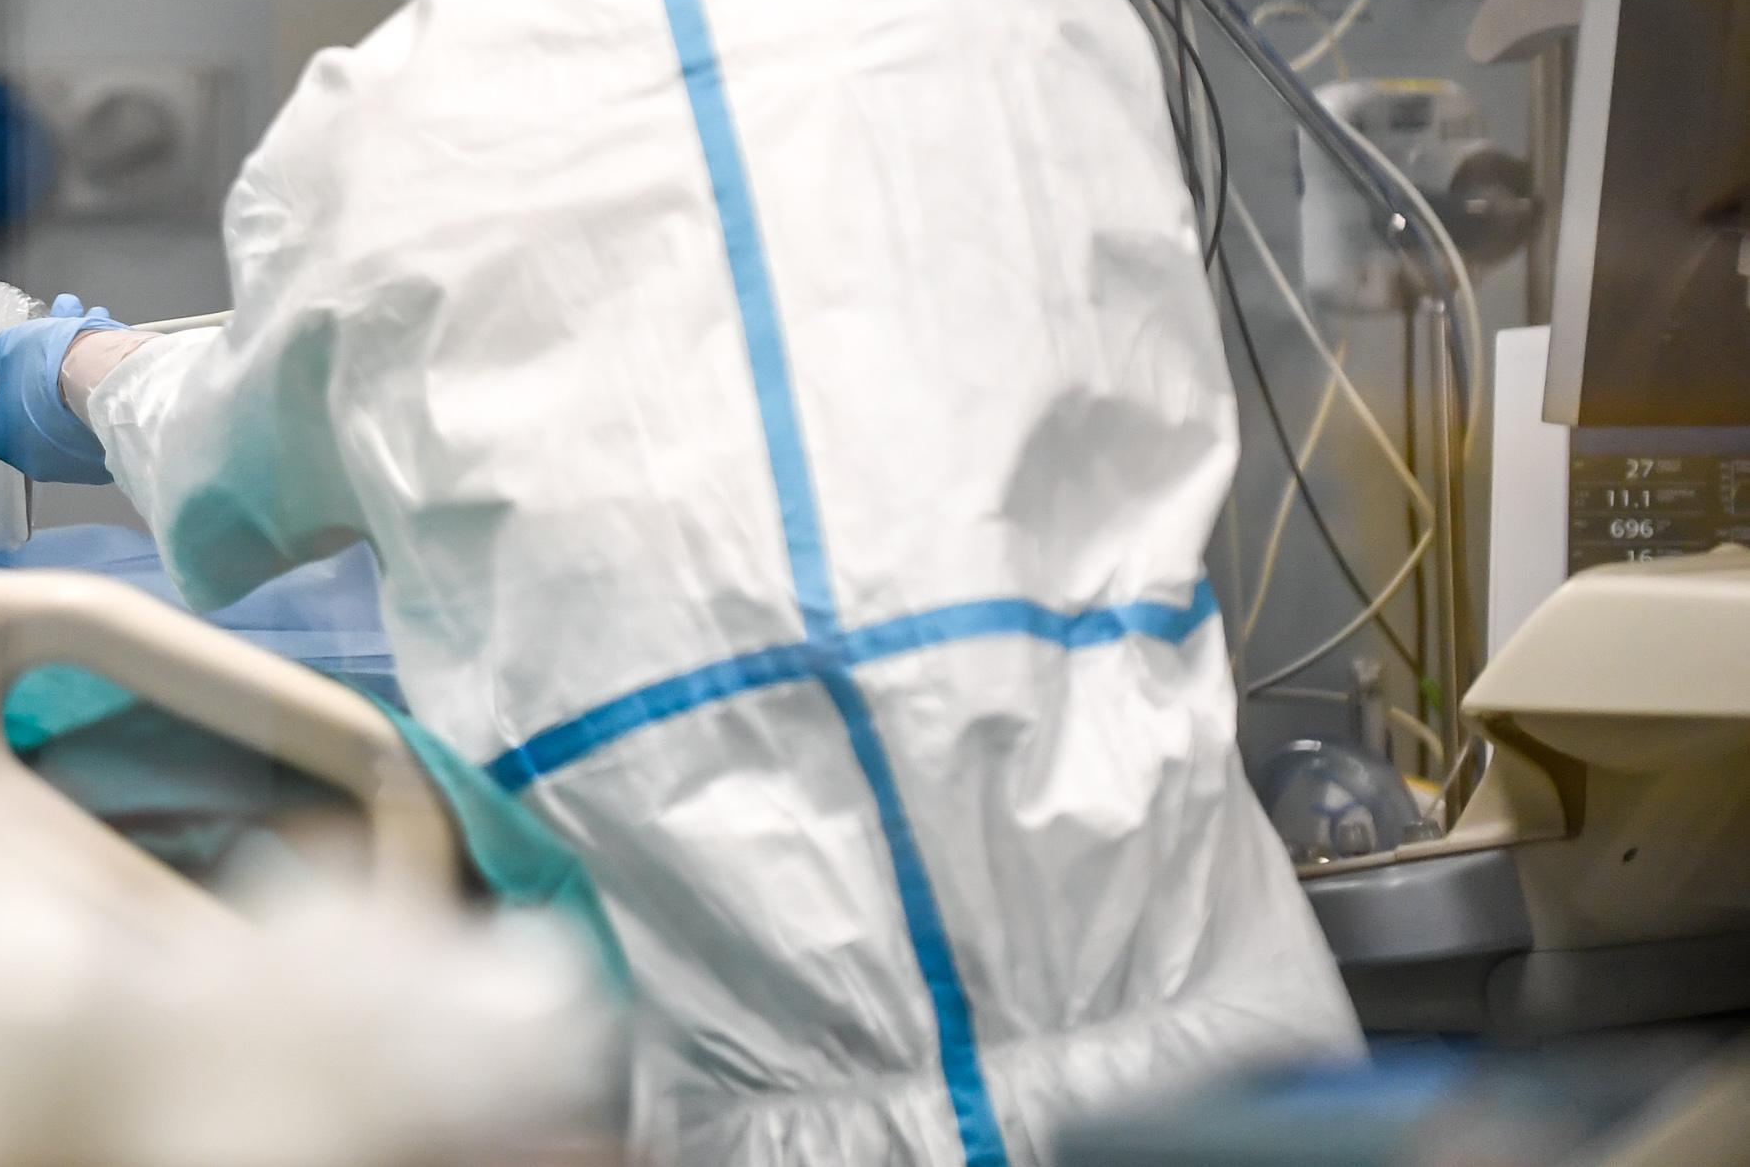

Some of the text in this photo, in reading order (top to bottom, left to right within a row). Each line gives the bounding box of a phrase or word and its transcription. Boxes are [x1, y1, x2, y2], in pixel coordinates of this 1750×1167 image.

[1626, 458, 1654, 479] 27
[1607, 489, 1650, 509] 11.1
[1611, 518, 1654, 539] 696
